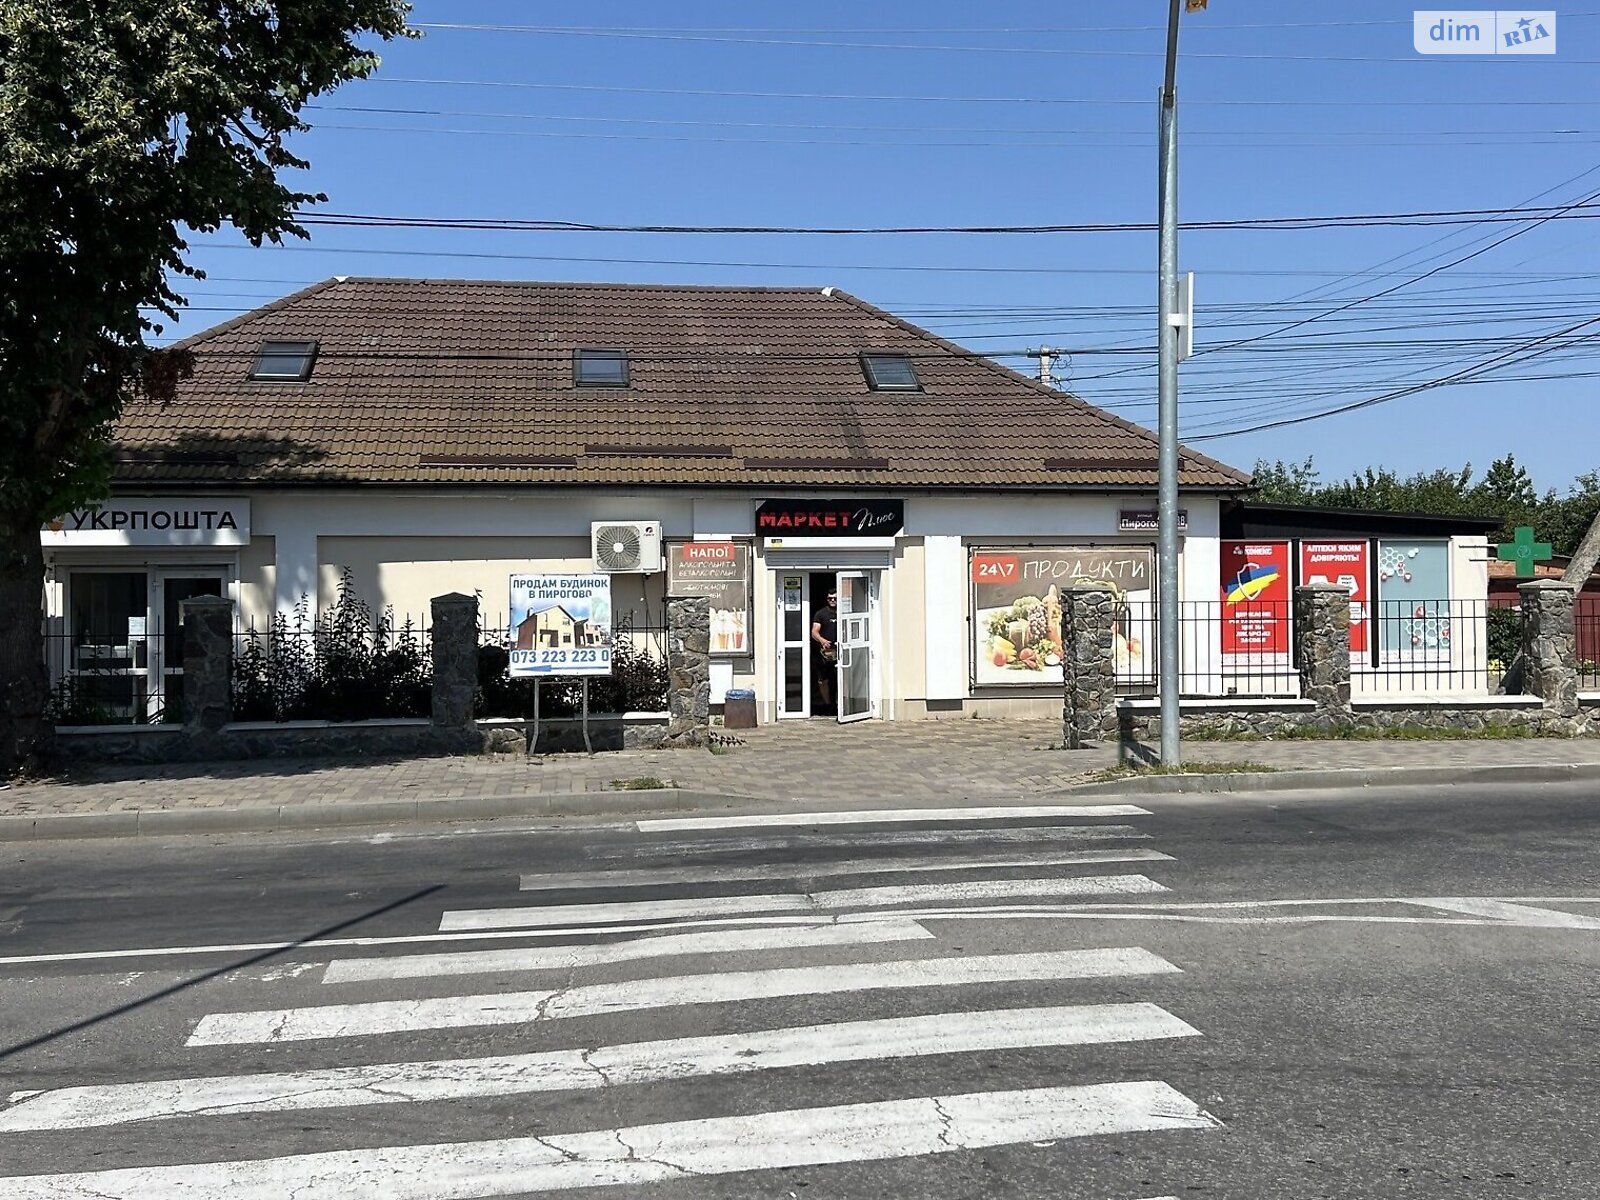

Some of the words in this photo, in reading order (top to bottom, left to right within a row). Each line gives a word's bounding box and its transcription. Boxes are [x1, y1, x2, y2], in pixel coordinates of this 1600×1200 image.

[71, 511, 238, 530] УКРПОШТА
[759, 512, 852, 528] МАРКЕТ
[1121, 519, 1160, 529] Пирого
[689, 546, 729, 558] НАПОЇ
[1306, 545, 1337, 553] АПТЕКИ
[1338, 545, 1362, 553] ЯКИМ
[1023, 560, 1146, 580] ПРОДУКТИ
[512, 579, 557, 589] ПРОДАМ
[560, 578, 608, 589] БУДИНОК
[528, 590, 536, 599] В
[511, 651, 537, 663] 073
[541, 650, 567, 662] 223
[571, 650, 597, 662] 223
[601, 649, 610, 661] 0
